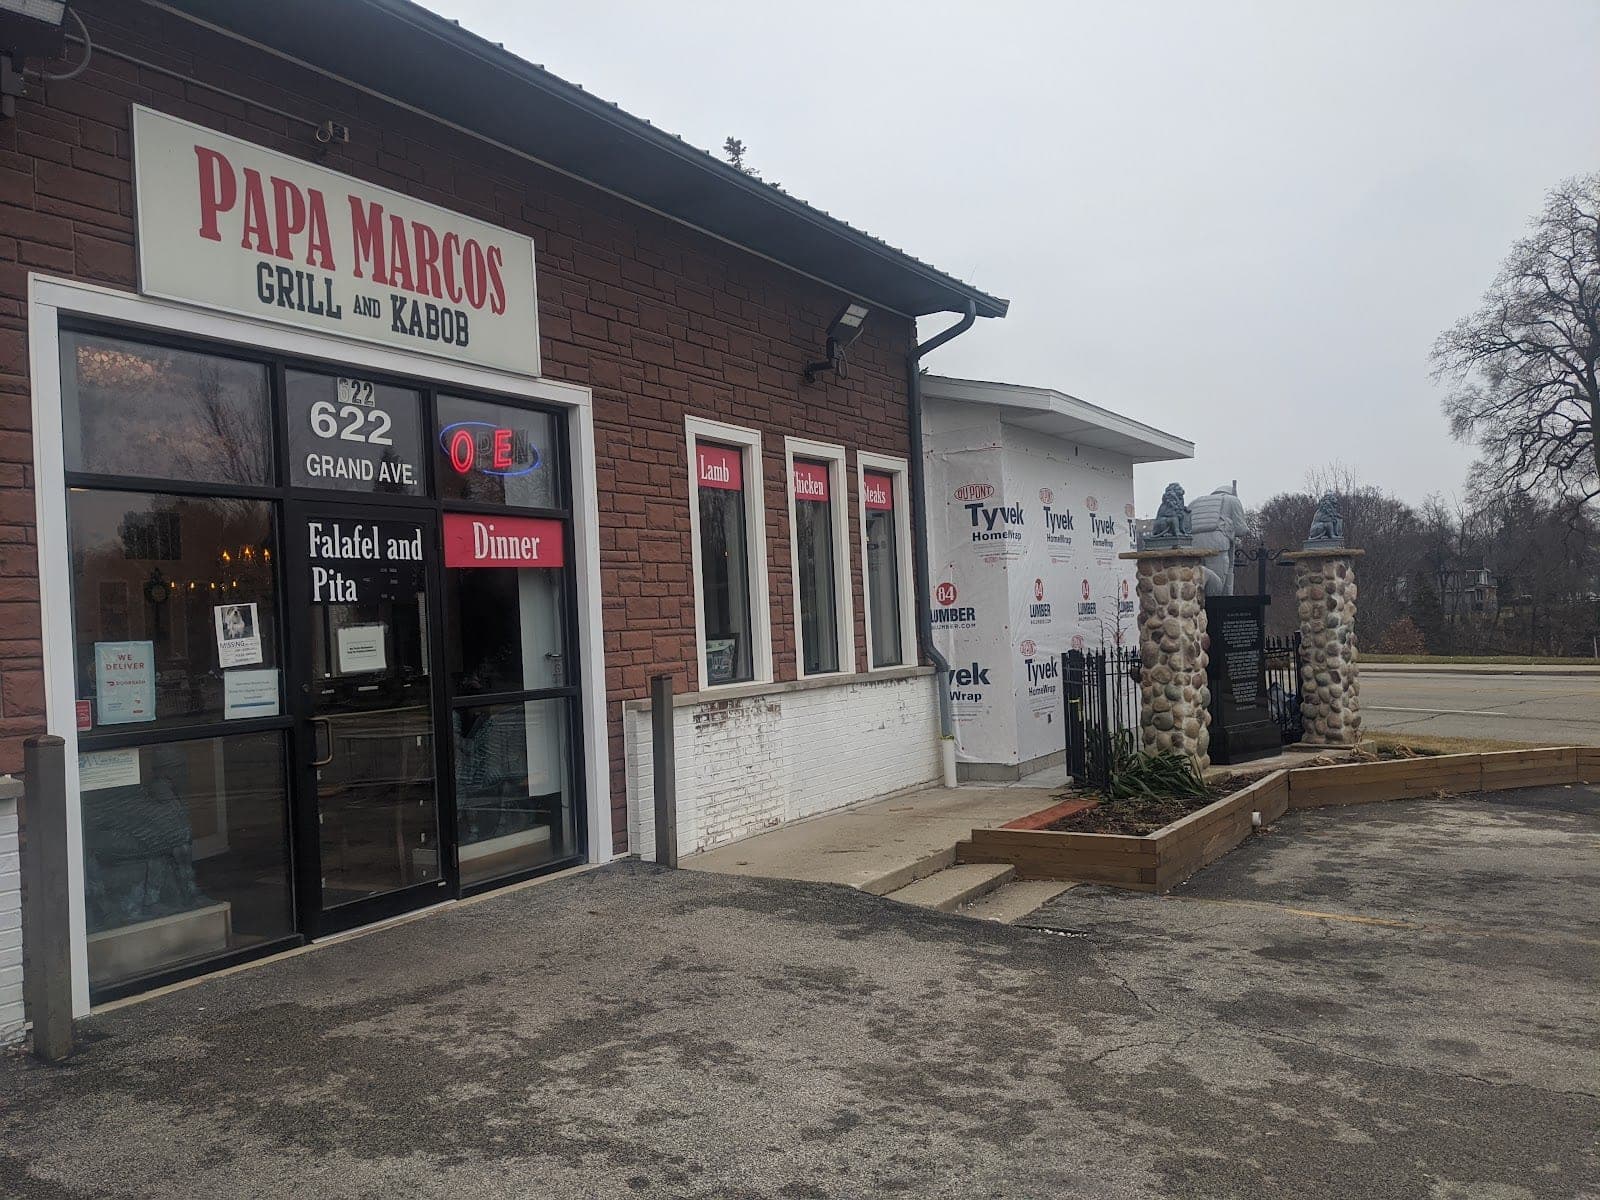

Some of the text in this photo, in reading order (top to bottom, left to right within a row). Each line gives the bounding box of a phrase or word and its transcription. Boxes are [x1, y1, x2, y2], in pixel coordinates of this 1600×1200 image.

[194, 145, 506, 316] PAPA MARCOS
[256, 261, 470, 347] GRILL AND KABOB
[310, 401, 393, 446] 622
[306, 453, 418, 486] GRAND AVE.
[699, 454, 730, 483] Lamb
[964, 501, 1025, 531] Tyvek
[1043, 506, 1074, 534] Tyvek
[1089, 512, 1115, 539] Tyvek
[308, 522, 423, 561] Falafel and
[472, 521, 541, 560] Dinner
[311, 566, 358, 602] Pita
[938, 586, 954, 602] 84
[1030, 603, 1051, 618] LUMBER
[105, 662, 145, 671] DELIVER
[948, 662, 991, 686] vek
[1024, 656, 1058, 687] Tyvek
[949, 691, 982, 703] Wrap
